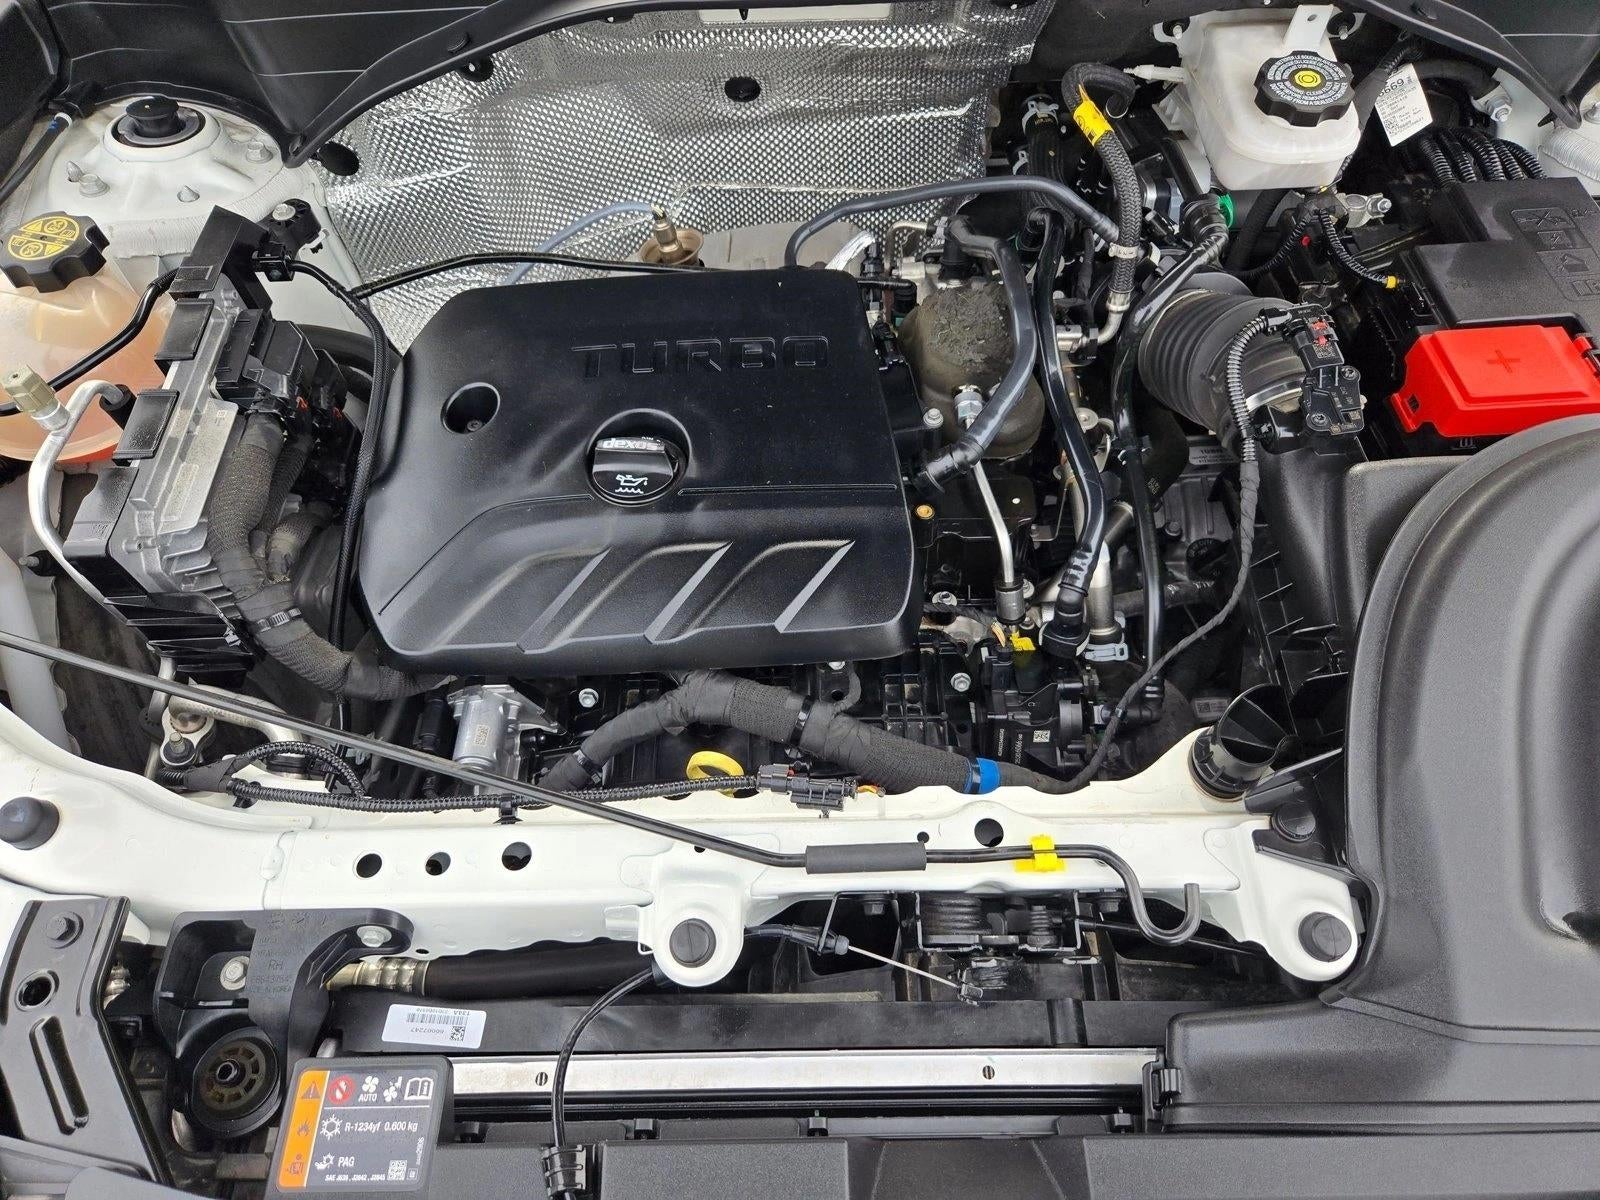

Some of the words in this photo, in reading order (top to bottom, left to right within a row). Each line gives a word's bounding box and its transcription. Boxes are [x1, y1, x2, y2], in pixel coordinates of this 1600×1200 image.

[571, 336, 829, 378] TURBO
[358, 1093, 377, 1102] AUTO
[344, 1121, 381, 1135] R-1234yf
[384, 1121, 406, 1131] 0.600
[407, 1121, 418, 1133] kg
[337, 1156, 355, 1168] PAG
